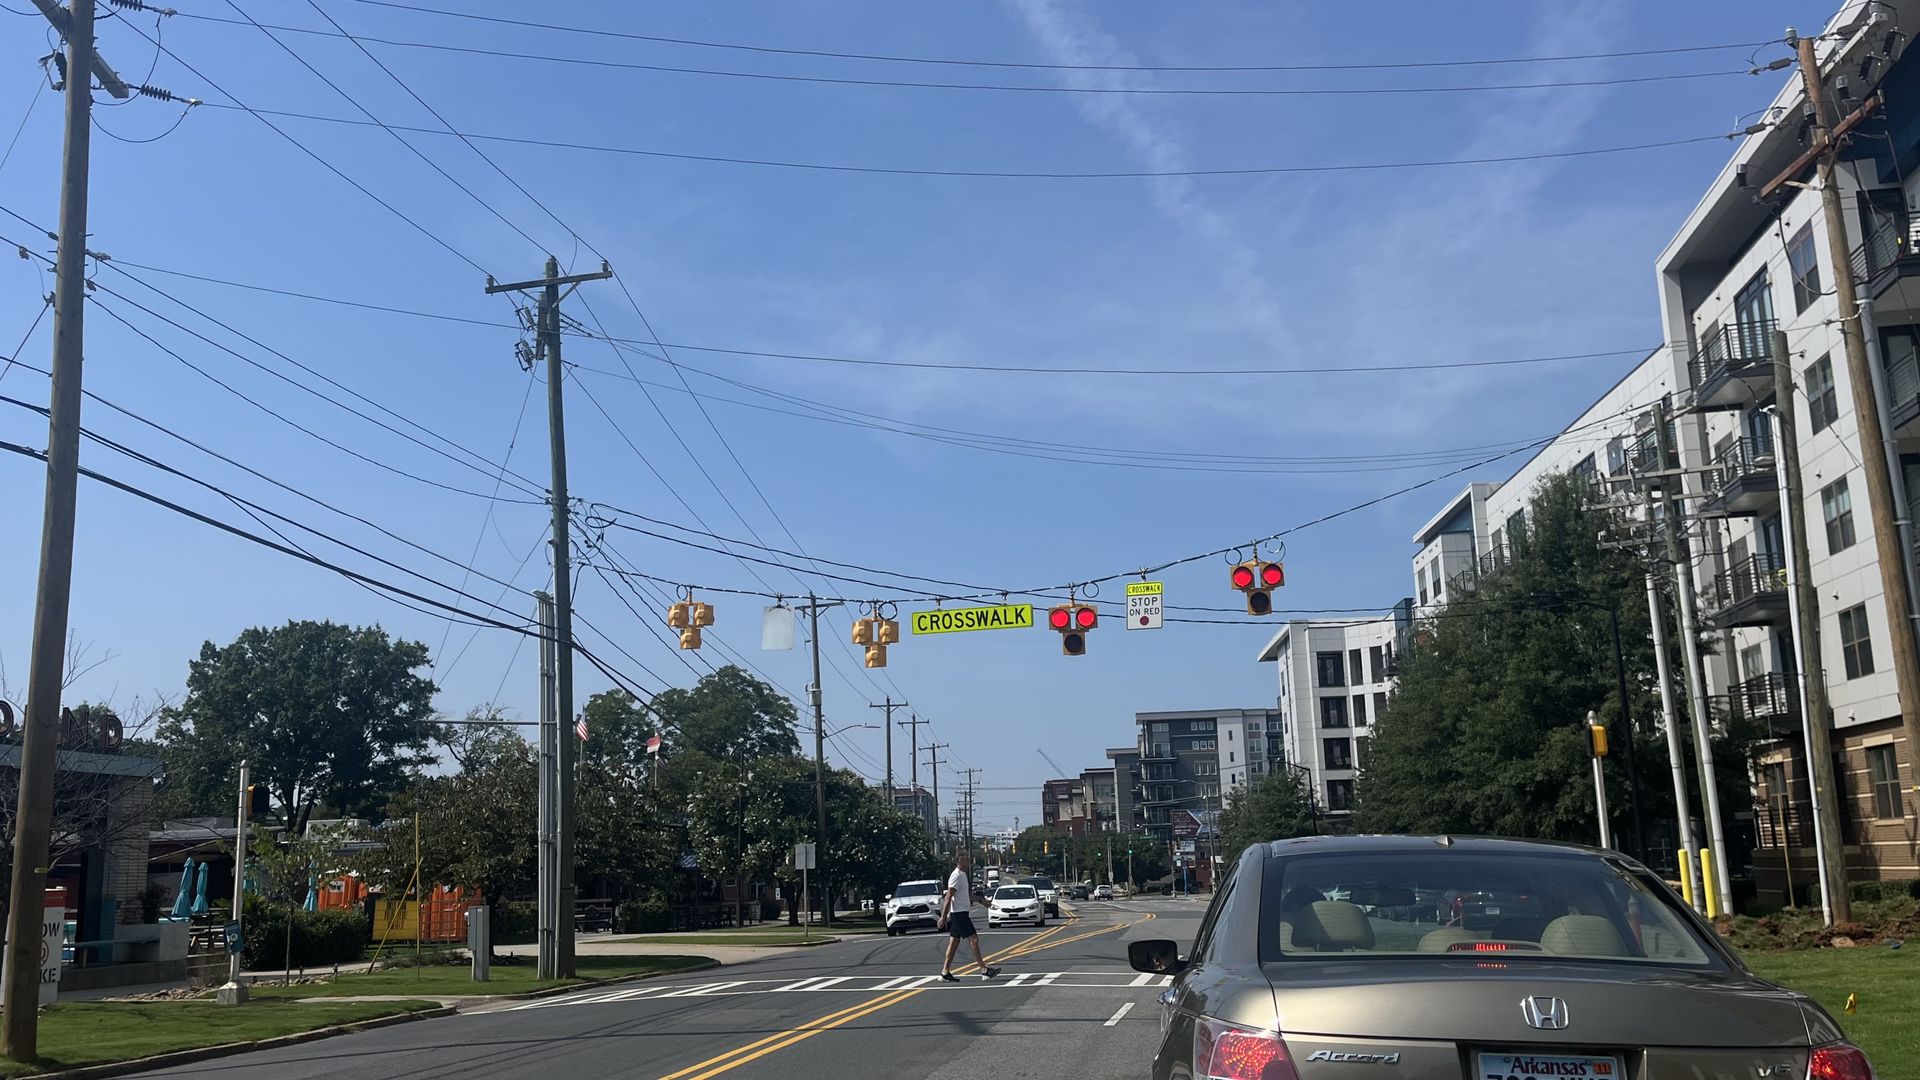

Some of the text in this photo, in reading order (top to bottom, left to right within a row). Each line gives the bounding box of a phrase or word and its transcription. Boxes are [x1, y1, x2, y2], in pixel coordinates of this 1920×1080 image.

[1128, 585, 1161, 594] CROSSWALK
[1131, 597, 1158, 607] STOP
[1129, 607, 1160, 616] ON RED
[917, 607, 1026, 631] CROSSWALK
[1306, 1050, 1400, 1064] Accord
[1511, 1056, 1587, 1075] Arkansas
[1754, 1063, 1791, 1077] V6
